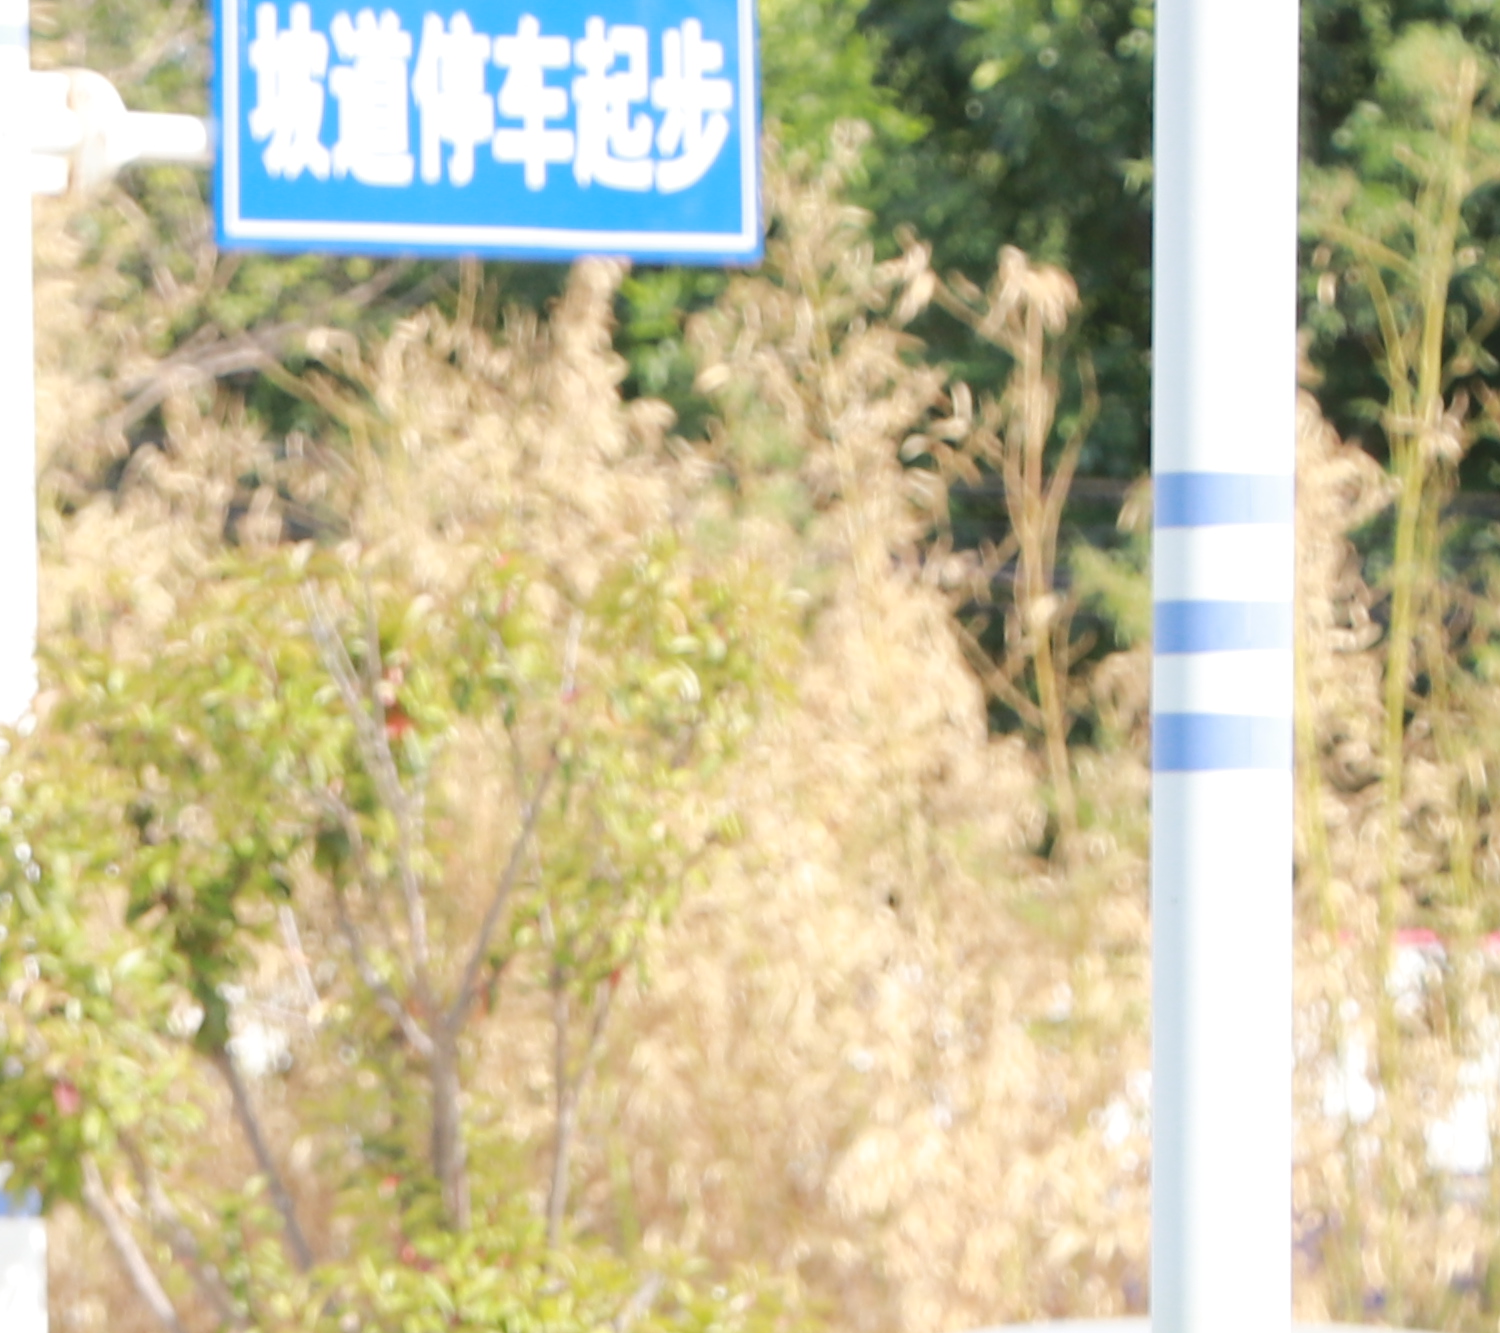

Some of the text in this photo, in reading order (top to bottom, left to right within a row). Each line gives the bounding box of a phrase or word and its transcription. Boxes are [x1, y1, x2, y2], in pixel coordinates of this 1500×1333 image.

[249, 2, 733, 193] 坡道停车起步
